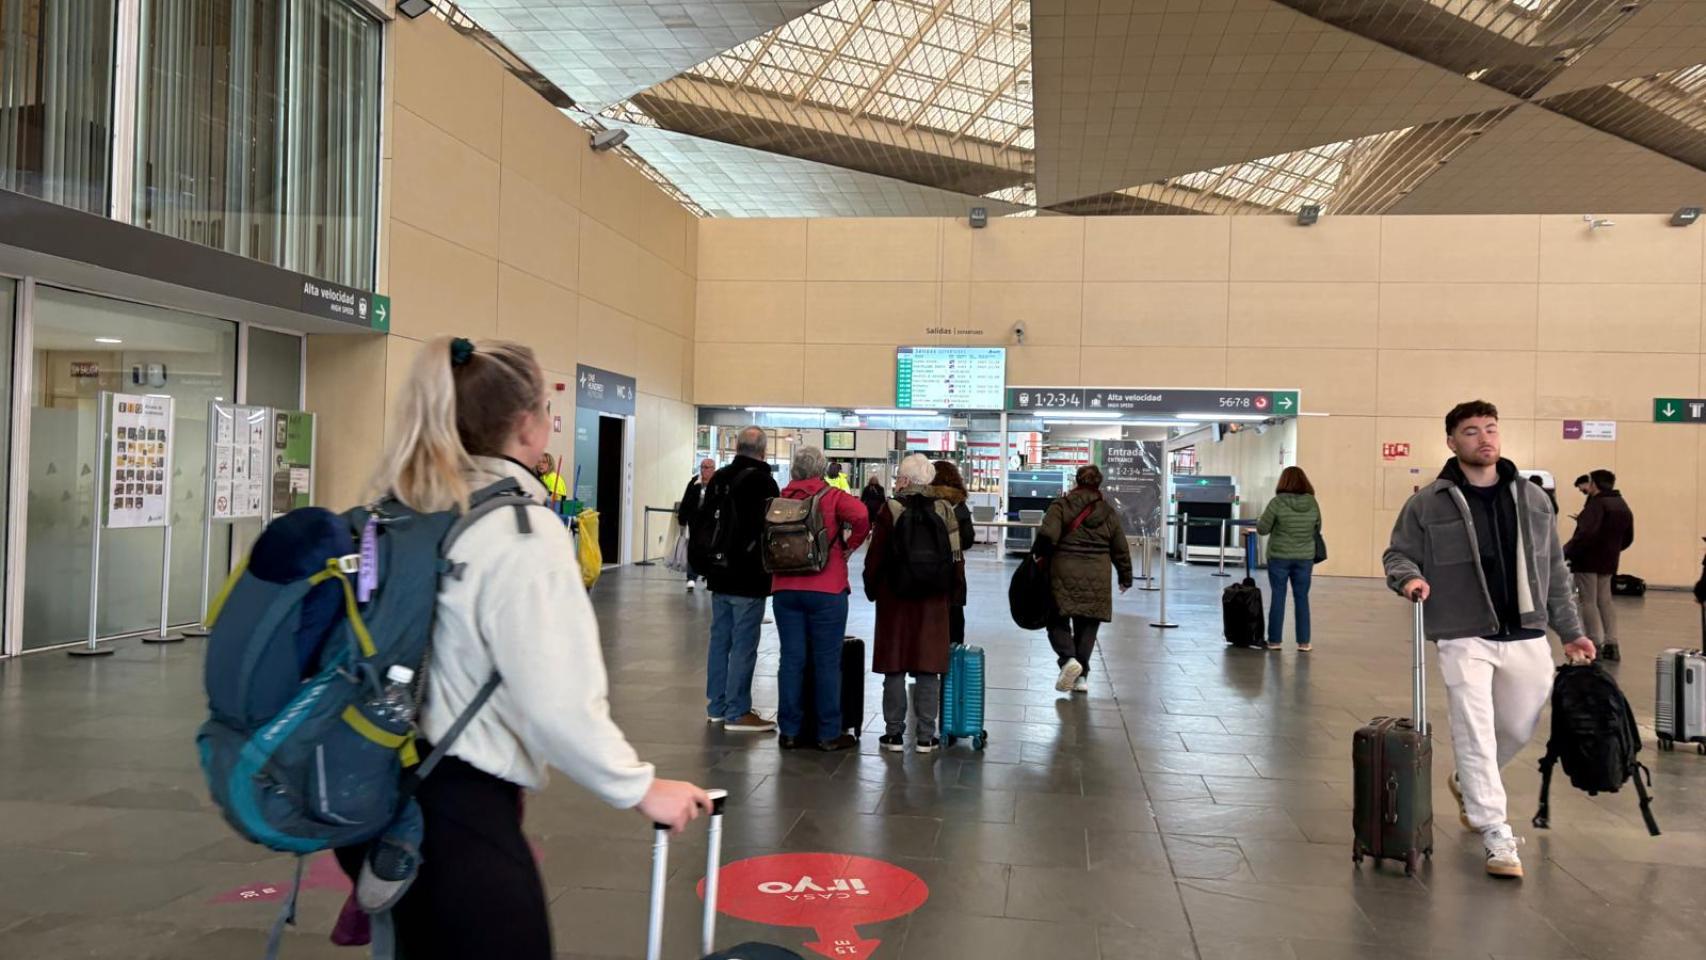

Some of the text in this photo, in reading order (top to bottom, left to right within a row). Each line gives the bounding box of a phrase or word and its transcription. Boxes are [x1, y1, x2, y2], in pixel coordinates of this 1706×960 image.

[304, 282, 355, 305] Alta velocidad
[926, 327, 951, 335] Salidas
[616, 385, 626, 399] WC
[1124, 393, 1162, 402] velocidad
[1108, 447, 1143, 457] Entrada
[757, 876, 870, 895] iryo
